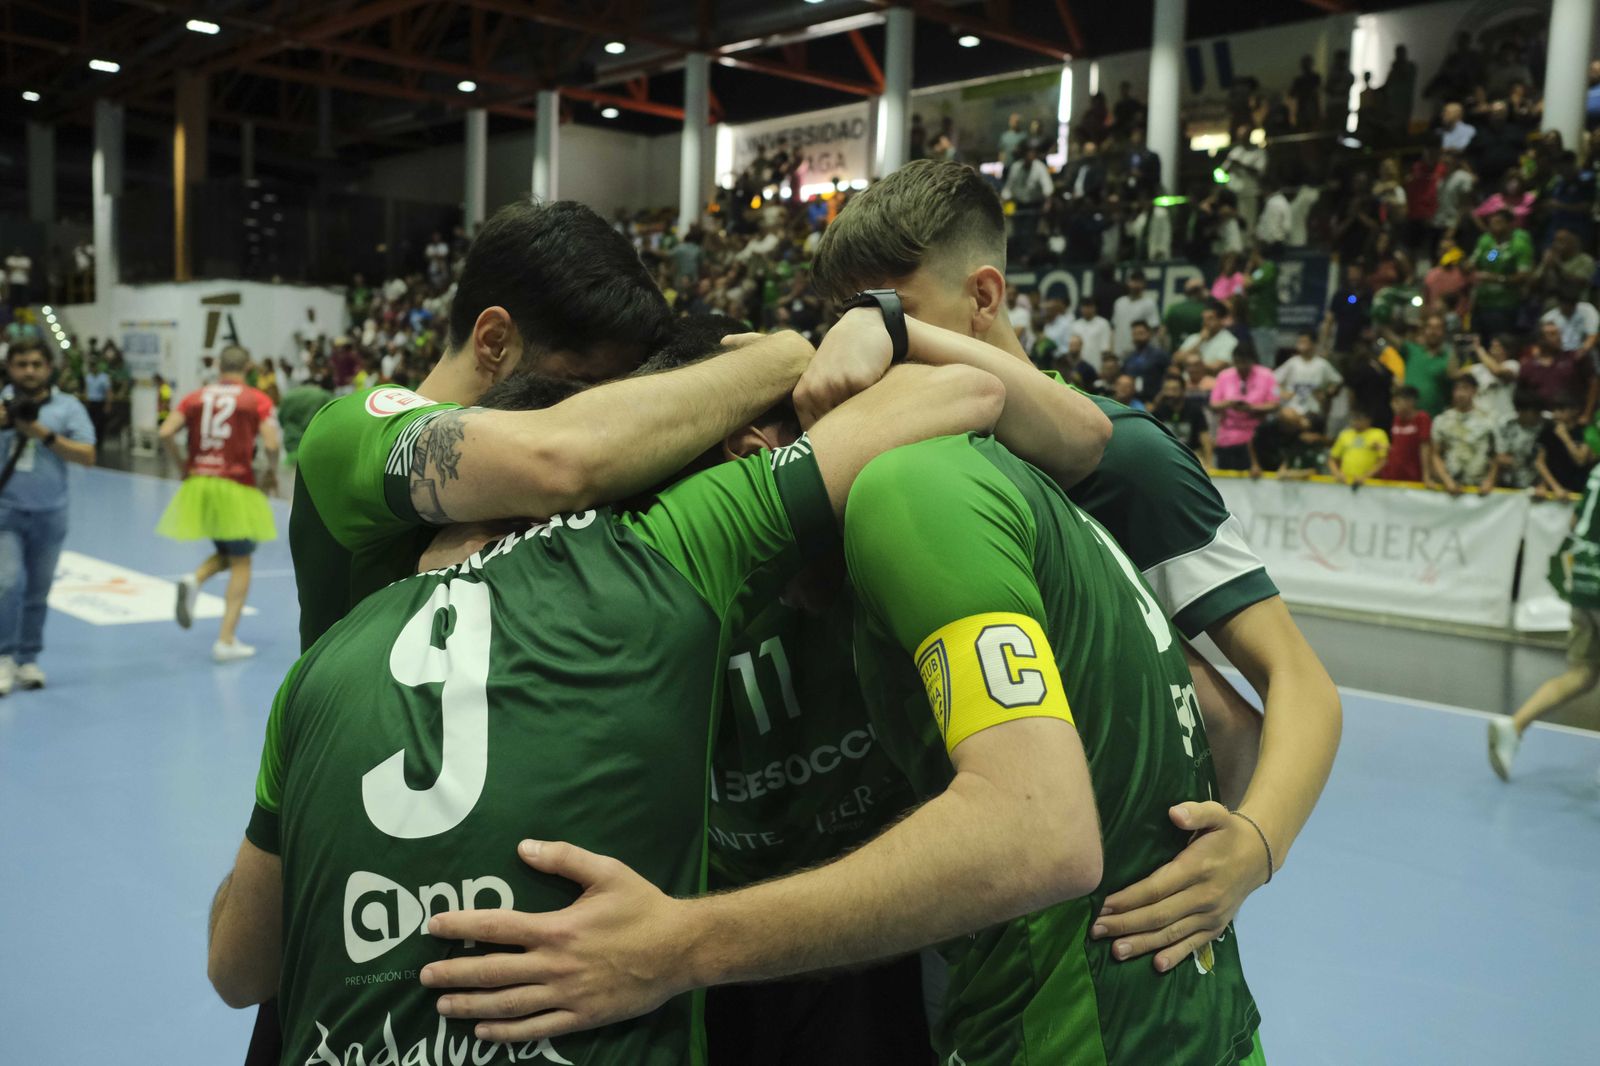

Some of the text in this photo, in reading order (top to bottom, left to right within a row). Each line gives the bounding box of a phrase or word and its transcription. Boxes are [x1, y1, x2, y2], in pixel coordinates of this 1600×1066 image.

[200, 391, 237, 440] 12
[727, 635, 801, 735] 11
[974, 624, 1048, 709] C
[362, 578, 492, 839] 9
[724, 722, 878, 803] BESOCC
[344, 969, 402, 986] PREVENCIÓN
